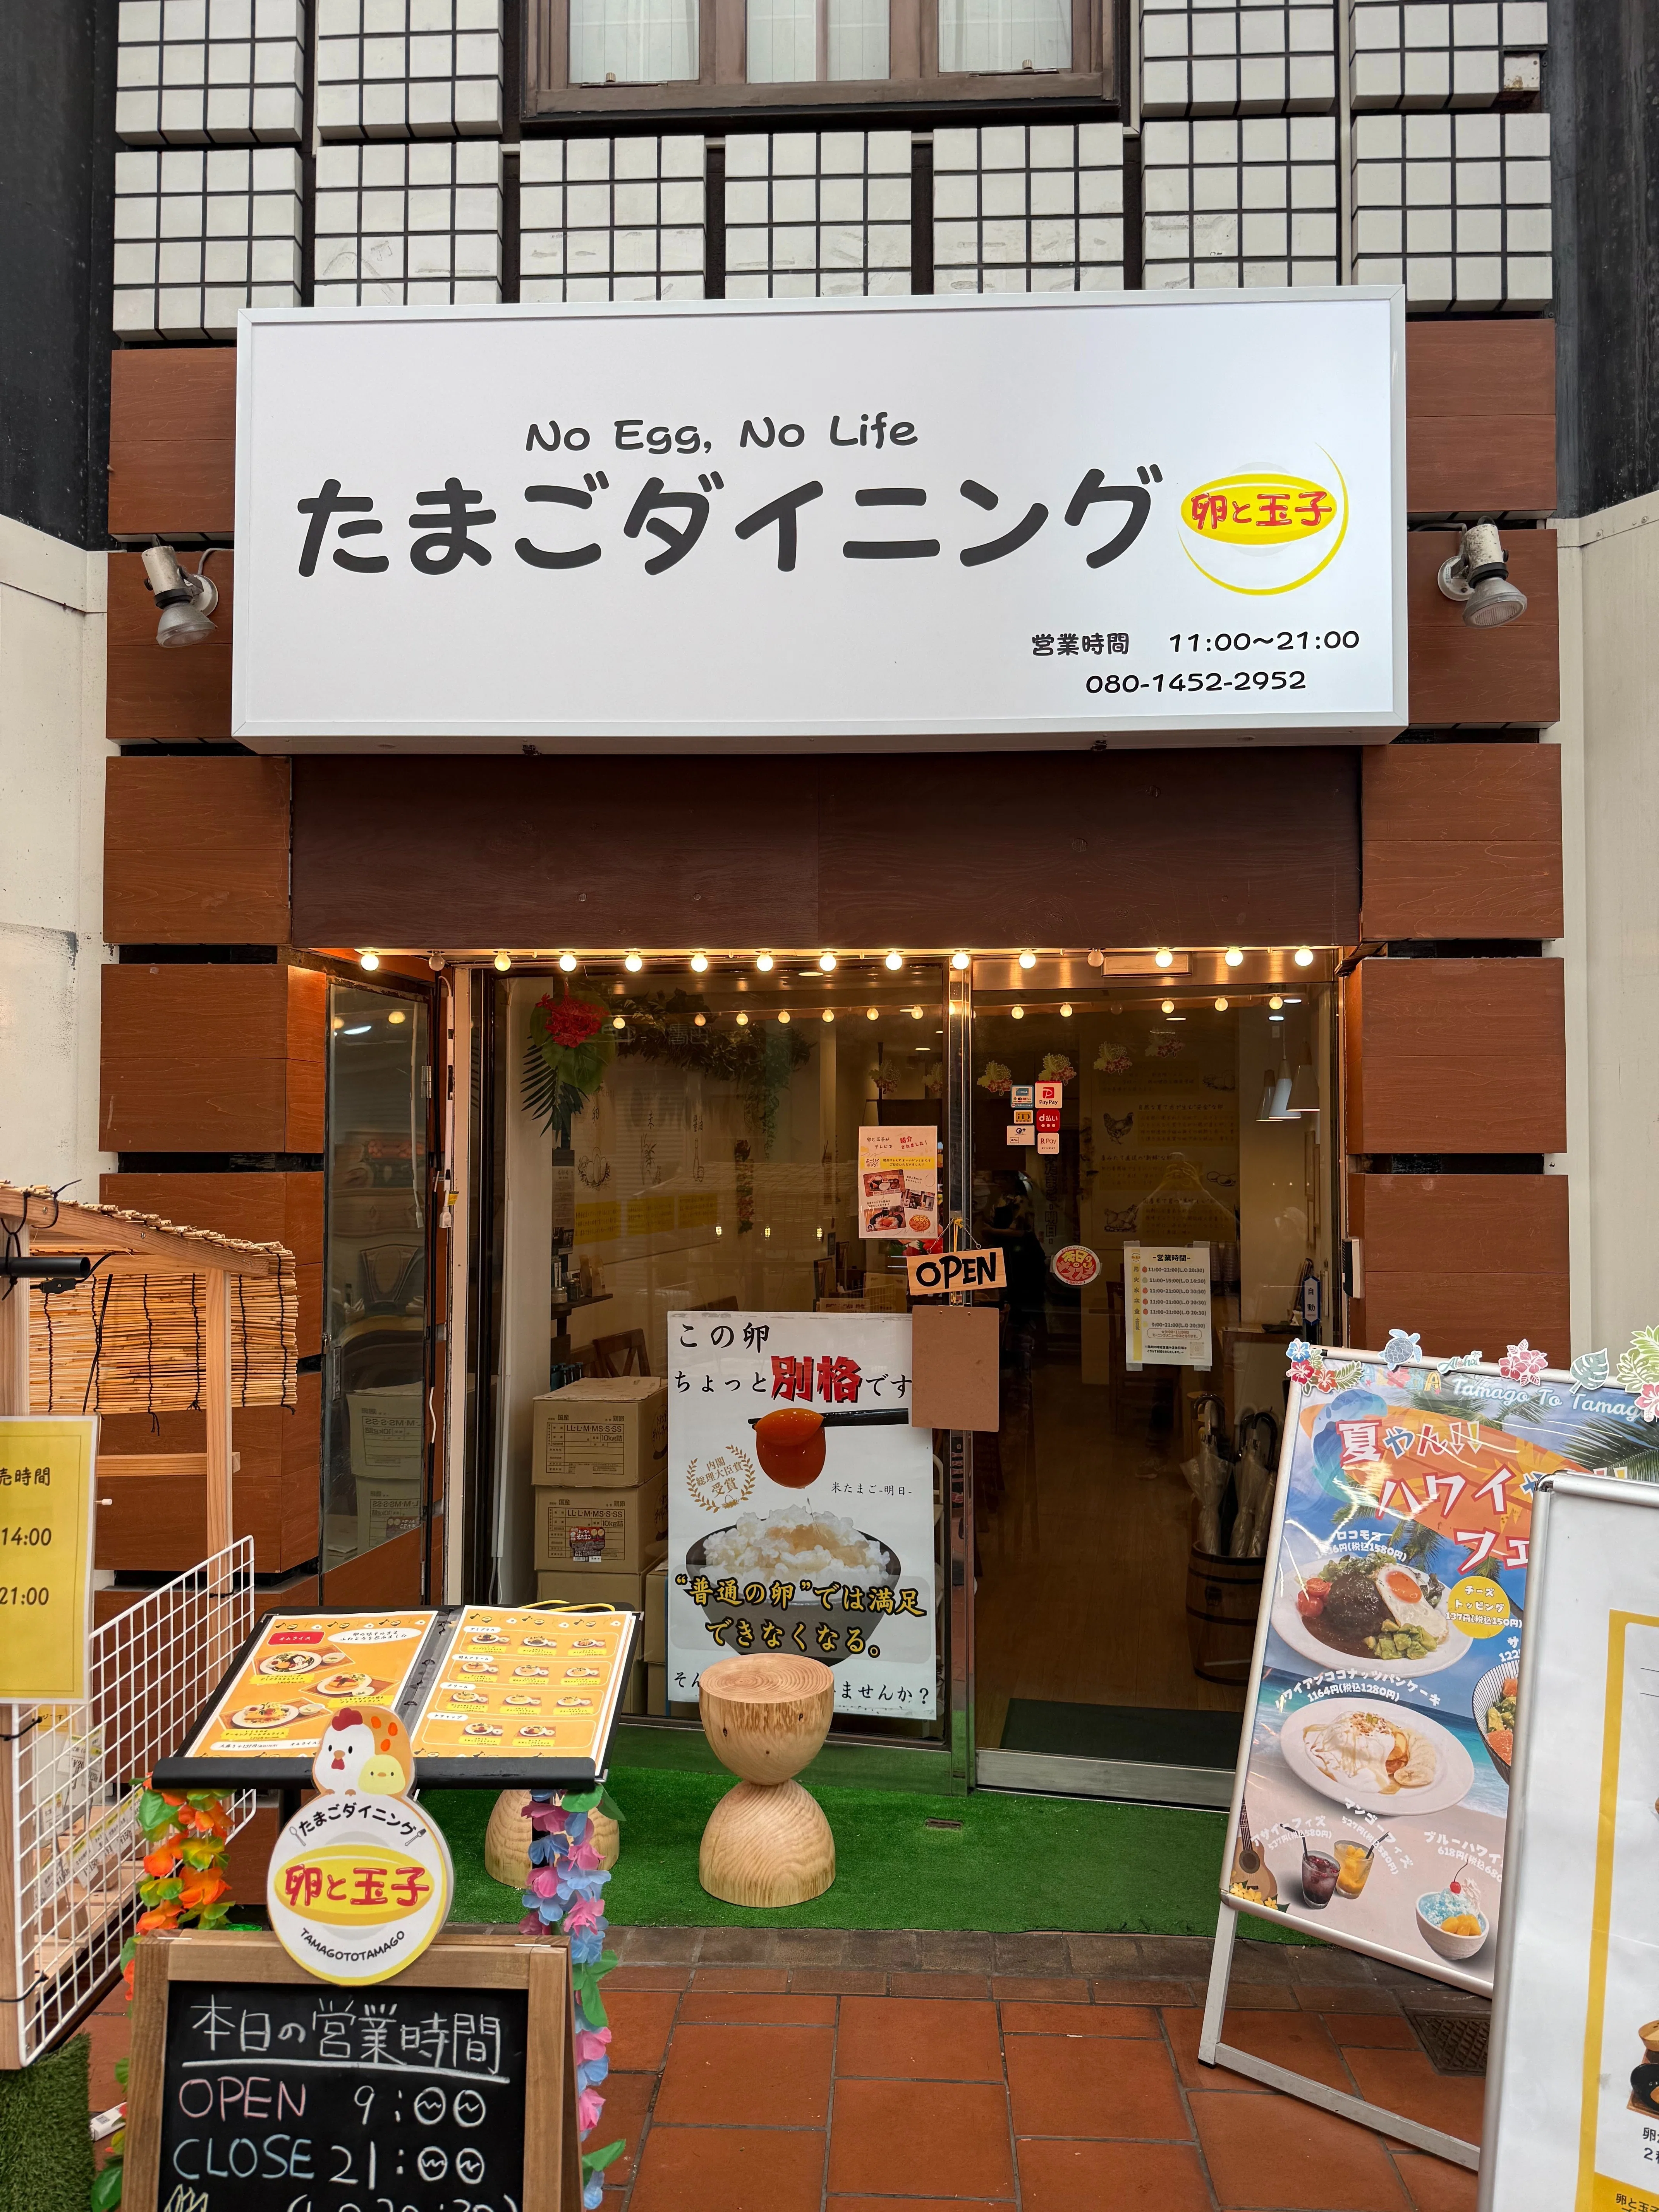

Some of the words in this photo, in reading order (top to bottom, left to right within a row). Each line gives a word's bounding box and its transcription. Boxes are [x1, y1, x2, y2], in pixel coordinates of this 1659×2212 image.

[526, 421, 590, 451] No
[615, 420, 711, 454] Egg,
[740, 417, 804, 447] No
[830, 412, 917, 448] Life
[298, 464, 1162, 577] たまごダイニング
[1191, 491, 1332, 530] 卵と玉子
[1032, 633, 1128, 656] 営業時間
[1086, 671, 1305, 693] 080-1452-2952
[1039, 1113, 1058, 1122] d払い
[916, 1252, 996, 1289] OPEN
[1308, 1288, 1315, 1311] 自動
[680, 1322, 770, 1353] この卵
[675, 1355, 913, 1403] ちょっと別格です
[1453, 1377, 1530, 1406] Tamago
[1538, 1389, 1563, 1407] To
[696, 1460, 744, 1486] 総理大臣賞
[706, 1457, 726, 1470] 内閣
[711, 1477, 738, 1497] 受賞
[2, 1526, 52, 1546] 14:00
[1336, 1530, 1380, 1541] ロコモコ
[0, 1587, 49, 1606] 21:00
[1464, 1585, 1495, 1597] チーズ
[1455, 1599, 1504, 1613] トッピング
[1446, 1612, 1522, 1628] 137円(税込150円)
[706, 1618, 880, 1658] できなくなる。
[833, 1681, 929, 1705] ませんか？
[1307, 1681, 1400, 1703] 1164円(税込1280円)
[299, 1802, 416, 1837] たまごダイニング
[1424, 1831, 1503, 1866] ブルーハワイ
[285, 1864, 429, 1906] 卵と玉子
[301, 1927, 405, 1961] TAMAGOTOTAMAGO
[190, 1994, 501, 2076] 本日の営業時間
[179, 2076, 306, 2121] OPEN
[1643, 2127, 1659, 2143] 卵
[173, 2134, 314, 2179] CLOSE
